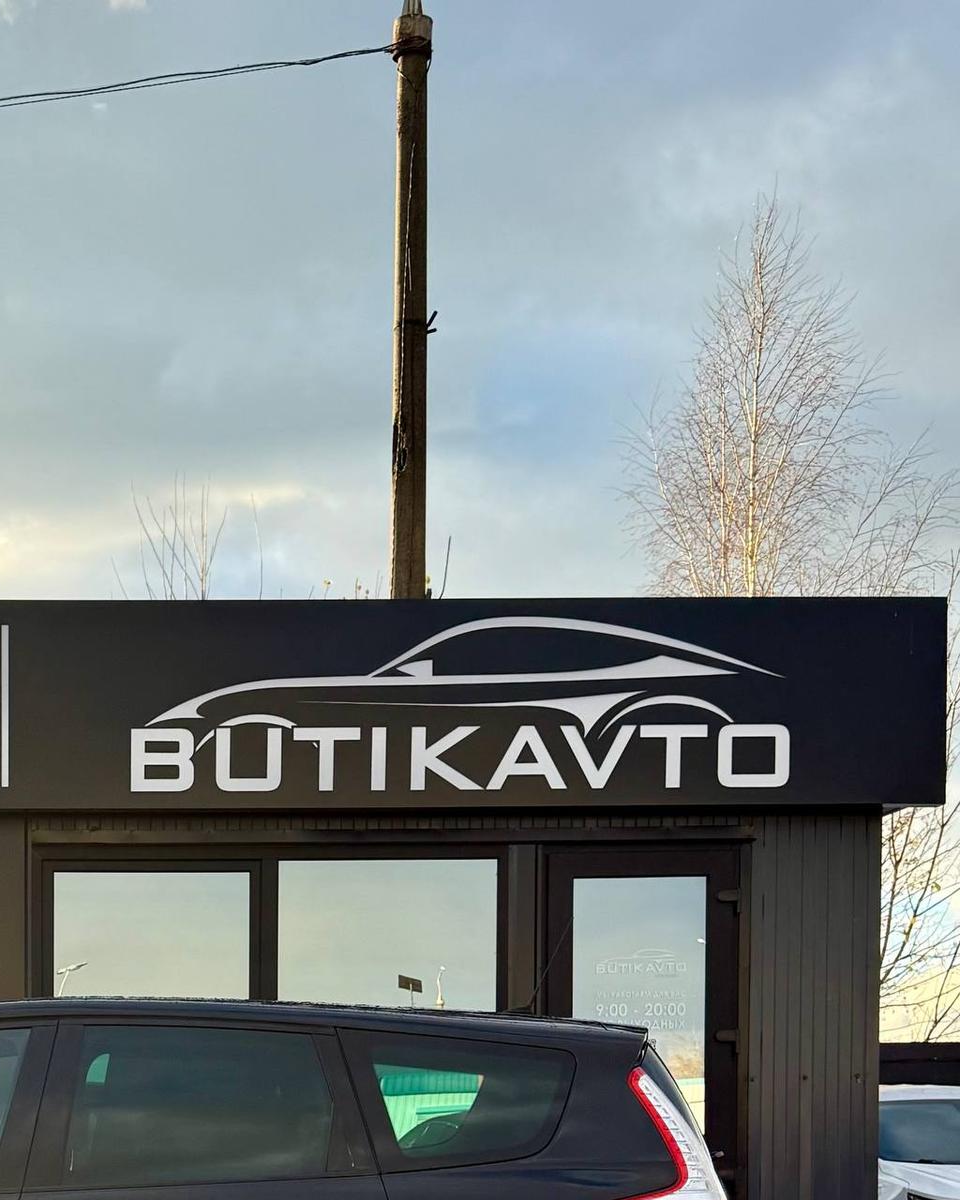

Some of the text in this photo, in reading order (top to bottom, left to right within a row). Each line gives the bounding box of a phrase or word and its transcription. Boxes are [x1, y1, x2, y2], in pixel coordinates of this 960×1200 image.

[130, 723, 791, 792] BUTIKAVTO
[596, 962, 687, 974] BUTIKAVTO
[596, 1003, 628, 1017] 9:00
[644, 1002, 686, 1016] 20:00
